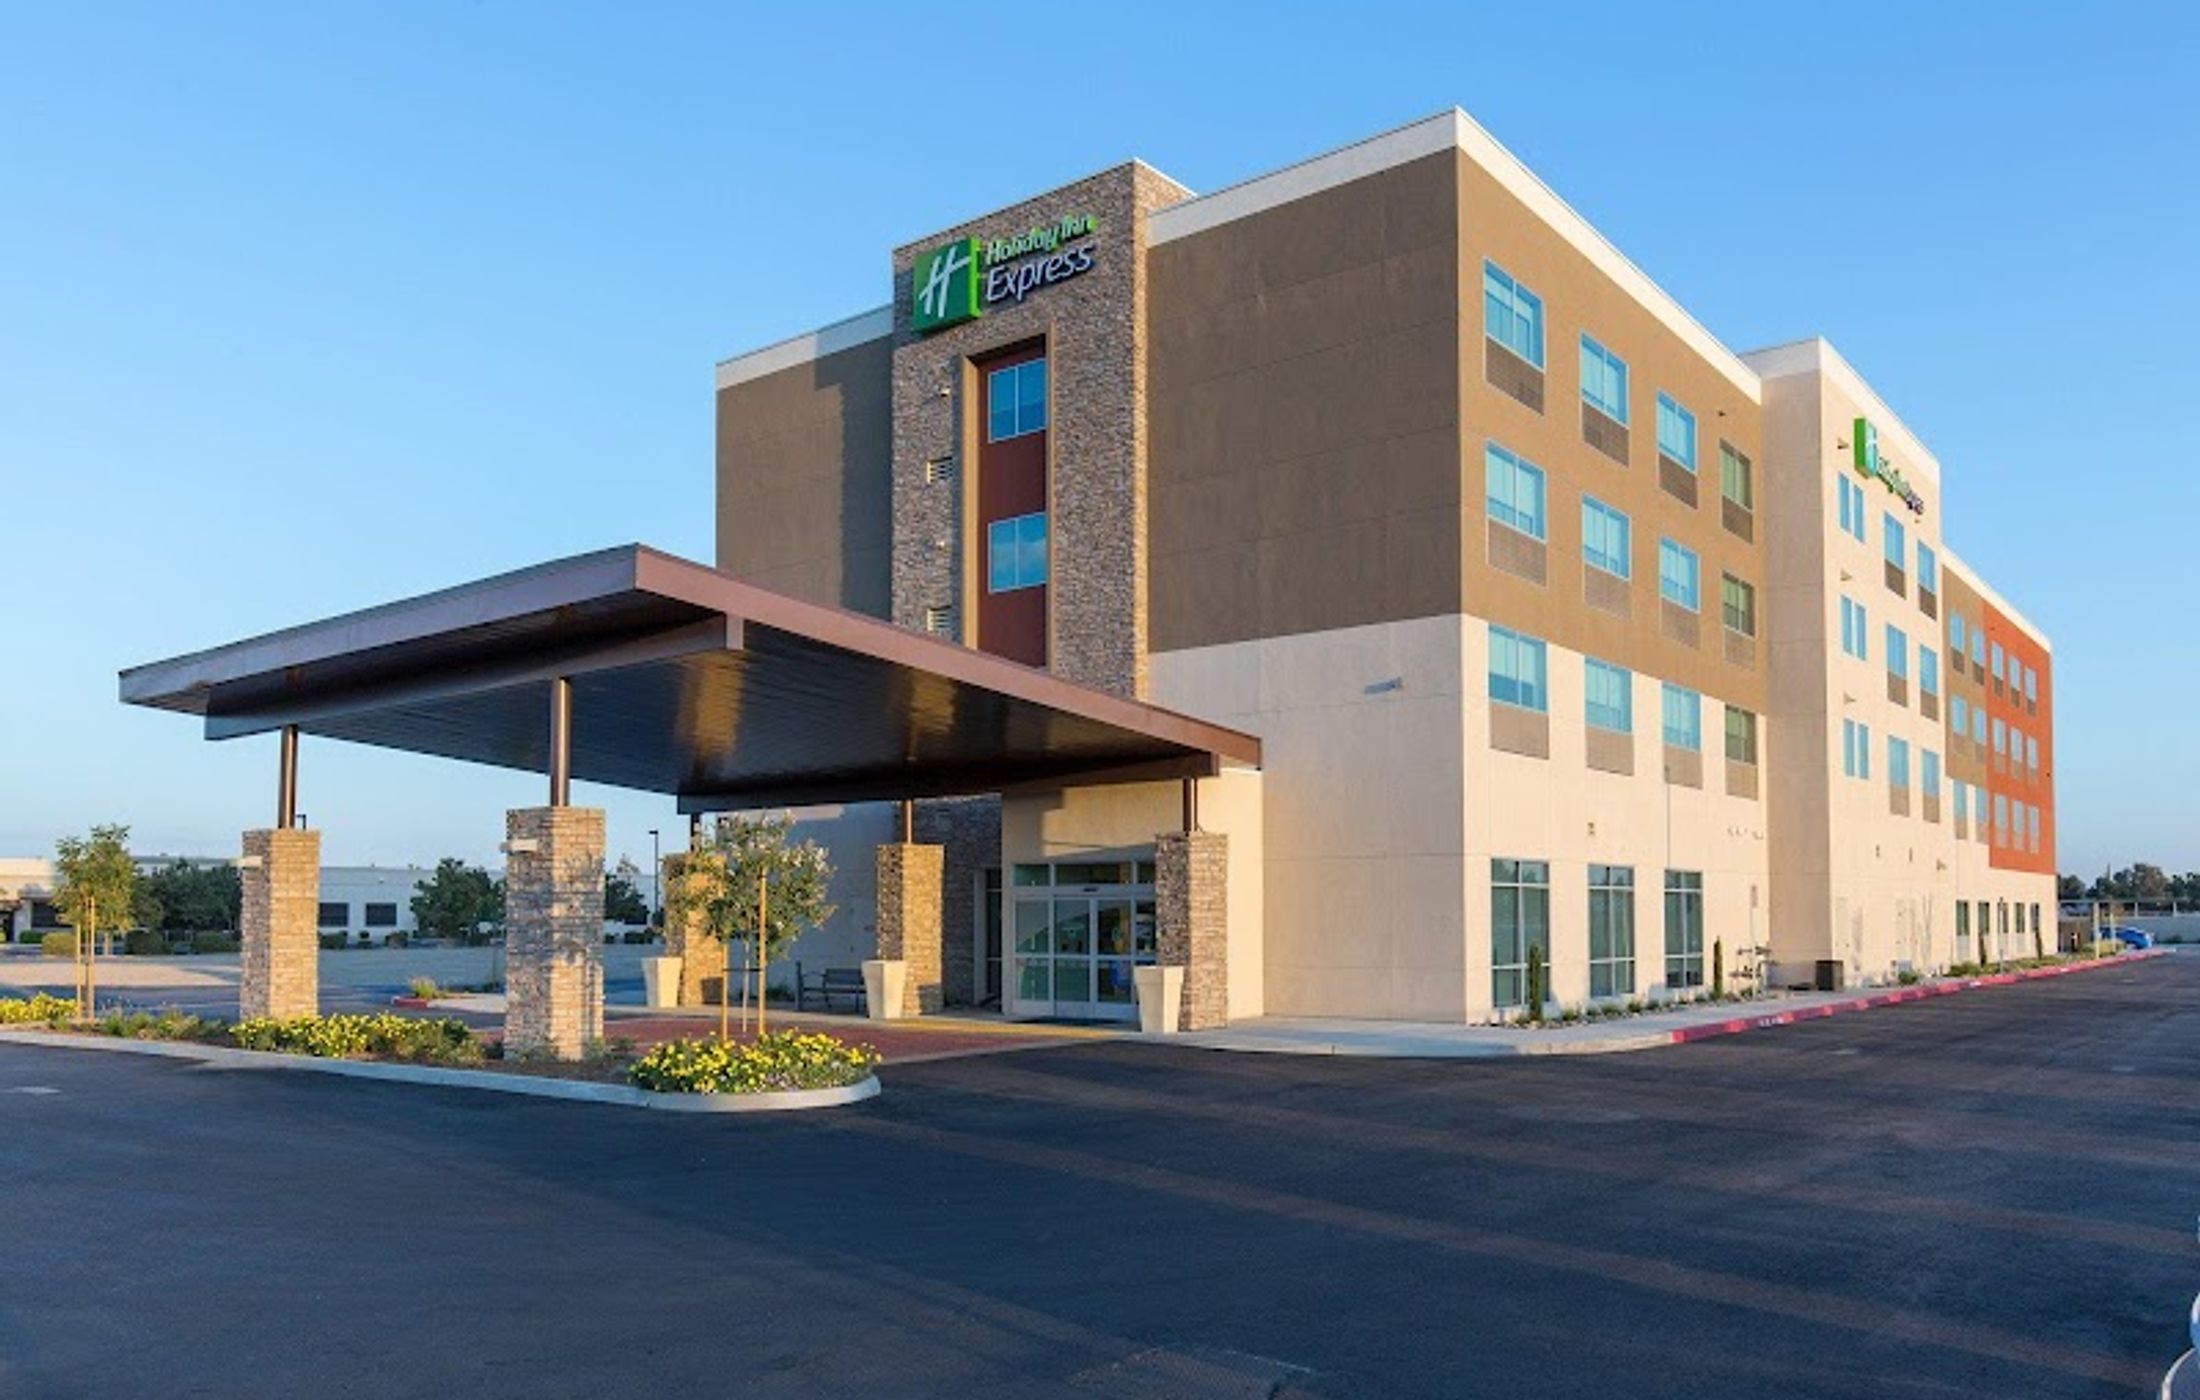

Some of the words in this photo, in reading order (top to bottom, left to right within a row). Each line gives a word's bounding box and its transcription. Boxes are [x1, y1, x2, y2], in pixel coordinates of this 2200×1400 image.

[985, 228, 1060, 265] Holiday
[1061, 214, 1096, 240] Inn
[986, 240, 1094, 301] Express
